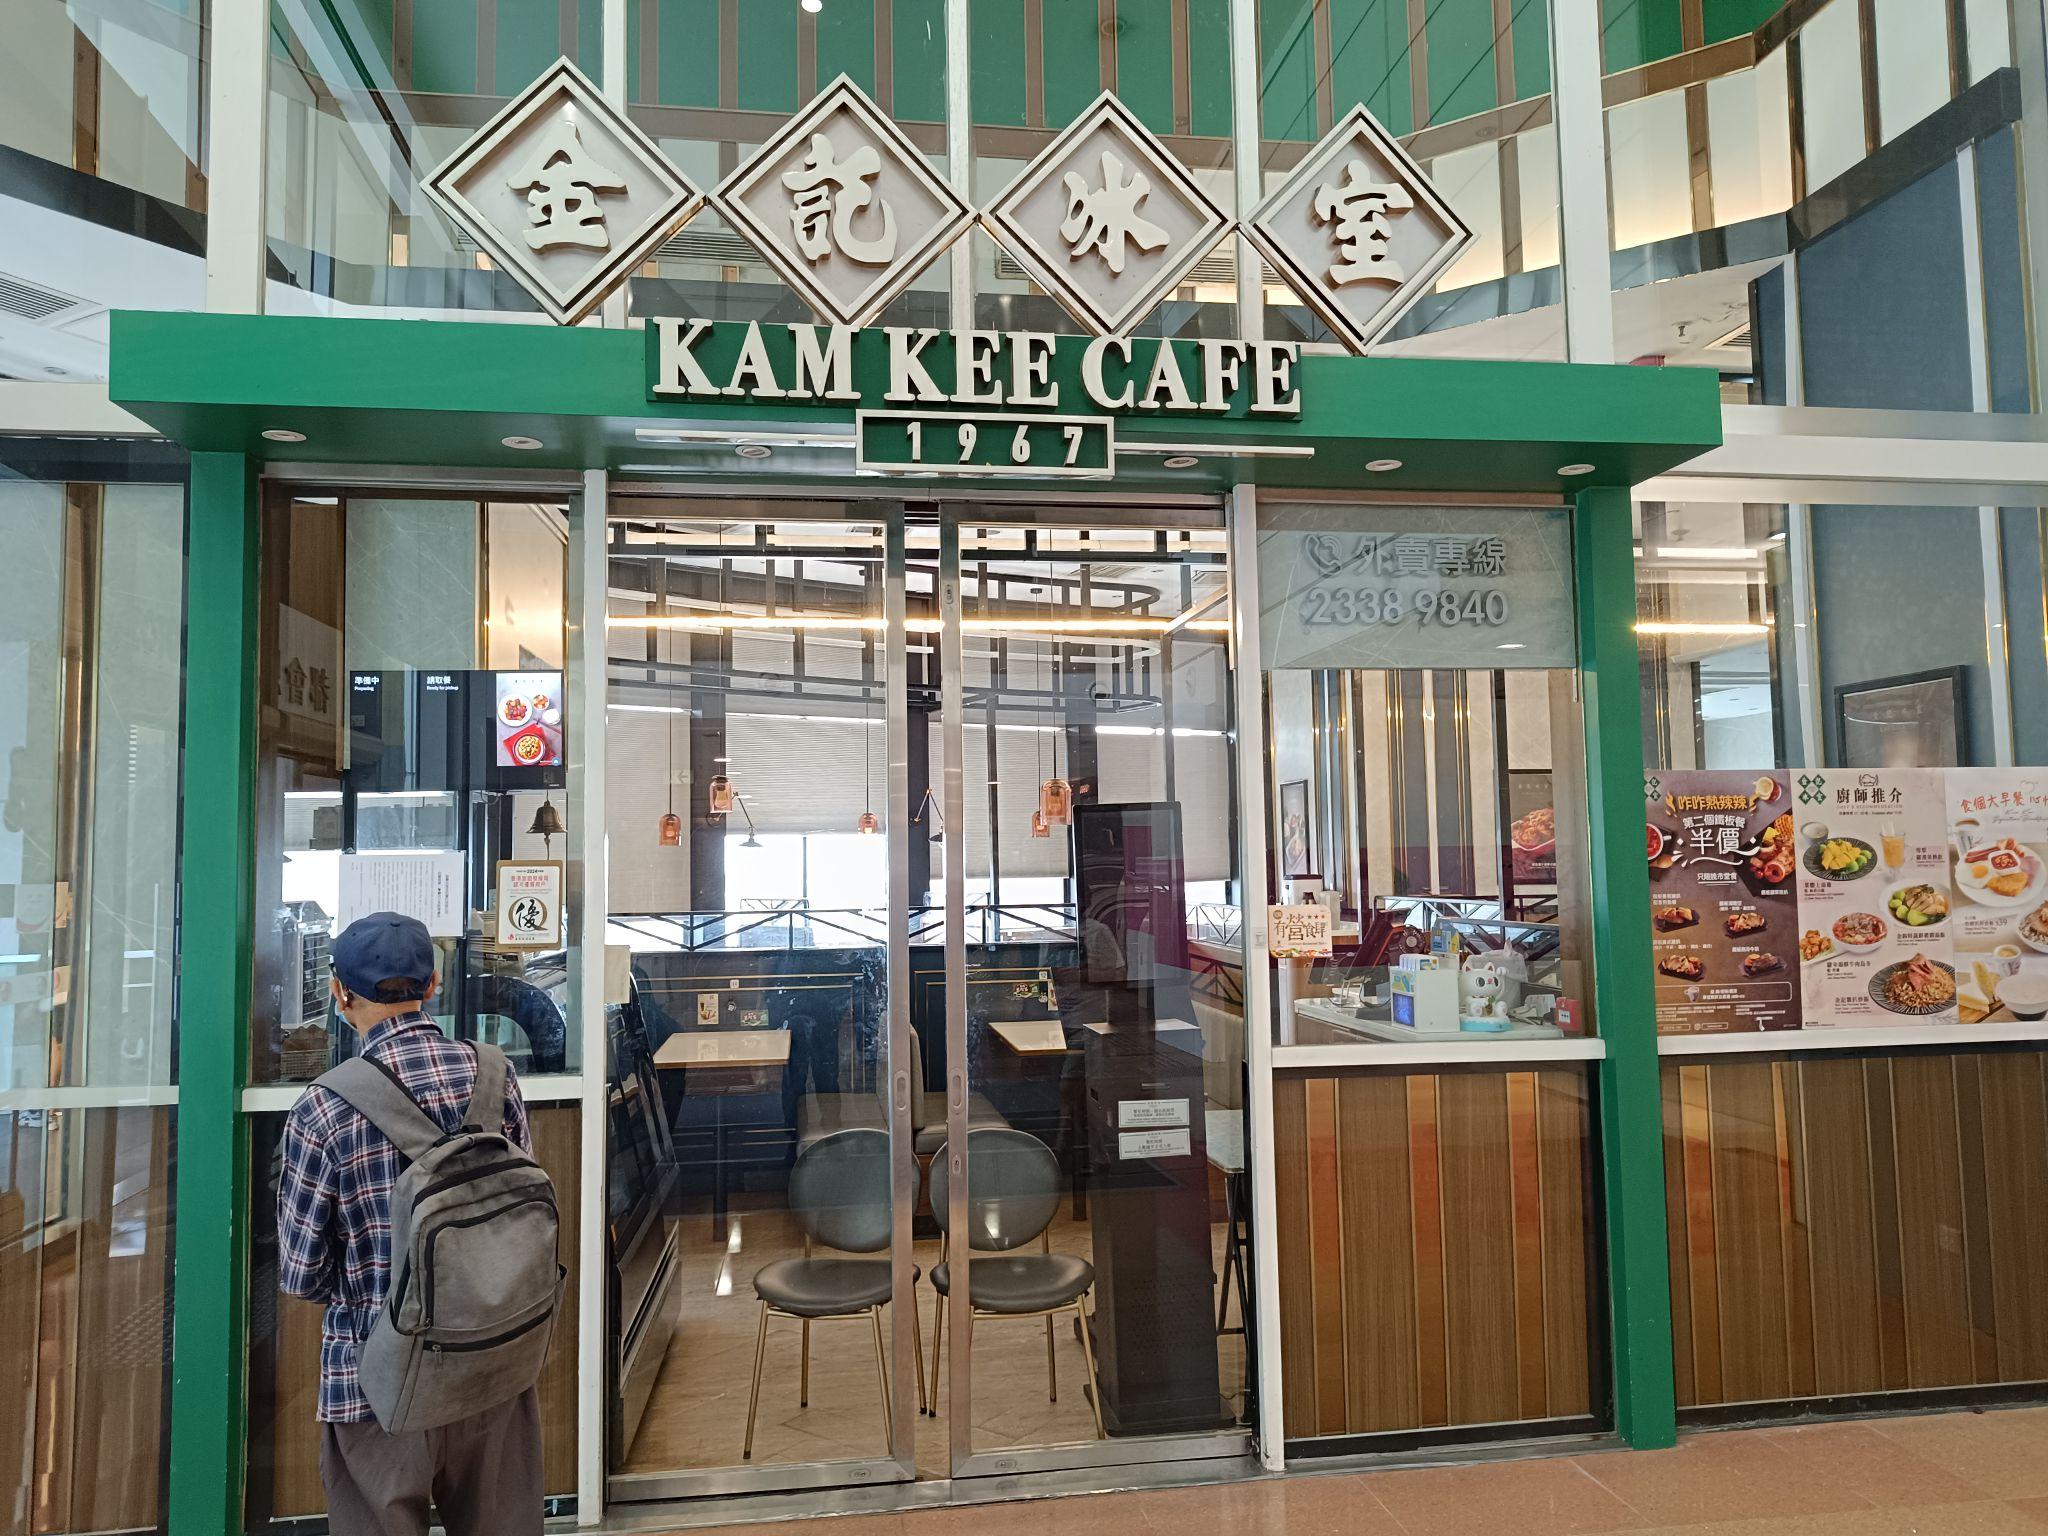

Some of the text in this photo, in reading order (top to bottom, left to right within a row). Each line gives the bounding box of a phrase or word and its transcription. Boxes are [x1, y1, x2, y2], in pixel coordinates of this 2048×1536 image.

[507, 120, 1414, 287] 金記冰室
[651, 316, 1302, 415] KAM KEE CAFE
[906, 421, 1083, 467] 1967
[1354, 534, 1508, 578] 外賣專線
[1307, 586, 1510, 628] 2338 9840
[1836, 787, 1903, 804] 廚師推介
[1690, 827, 1741, 855] 半價
[1274, 913, 1328, 941] 有營食肆
